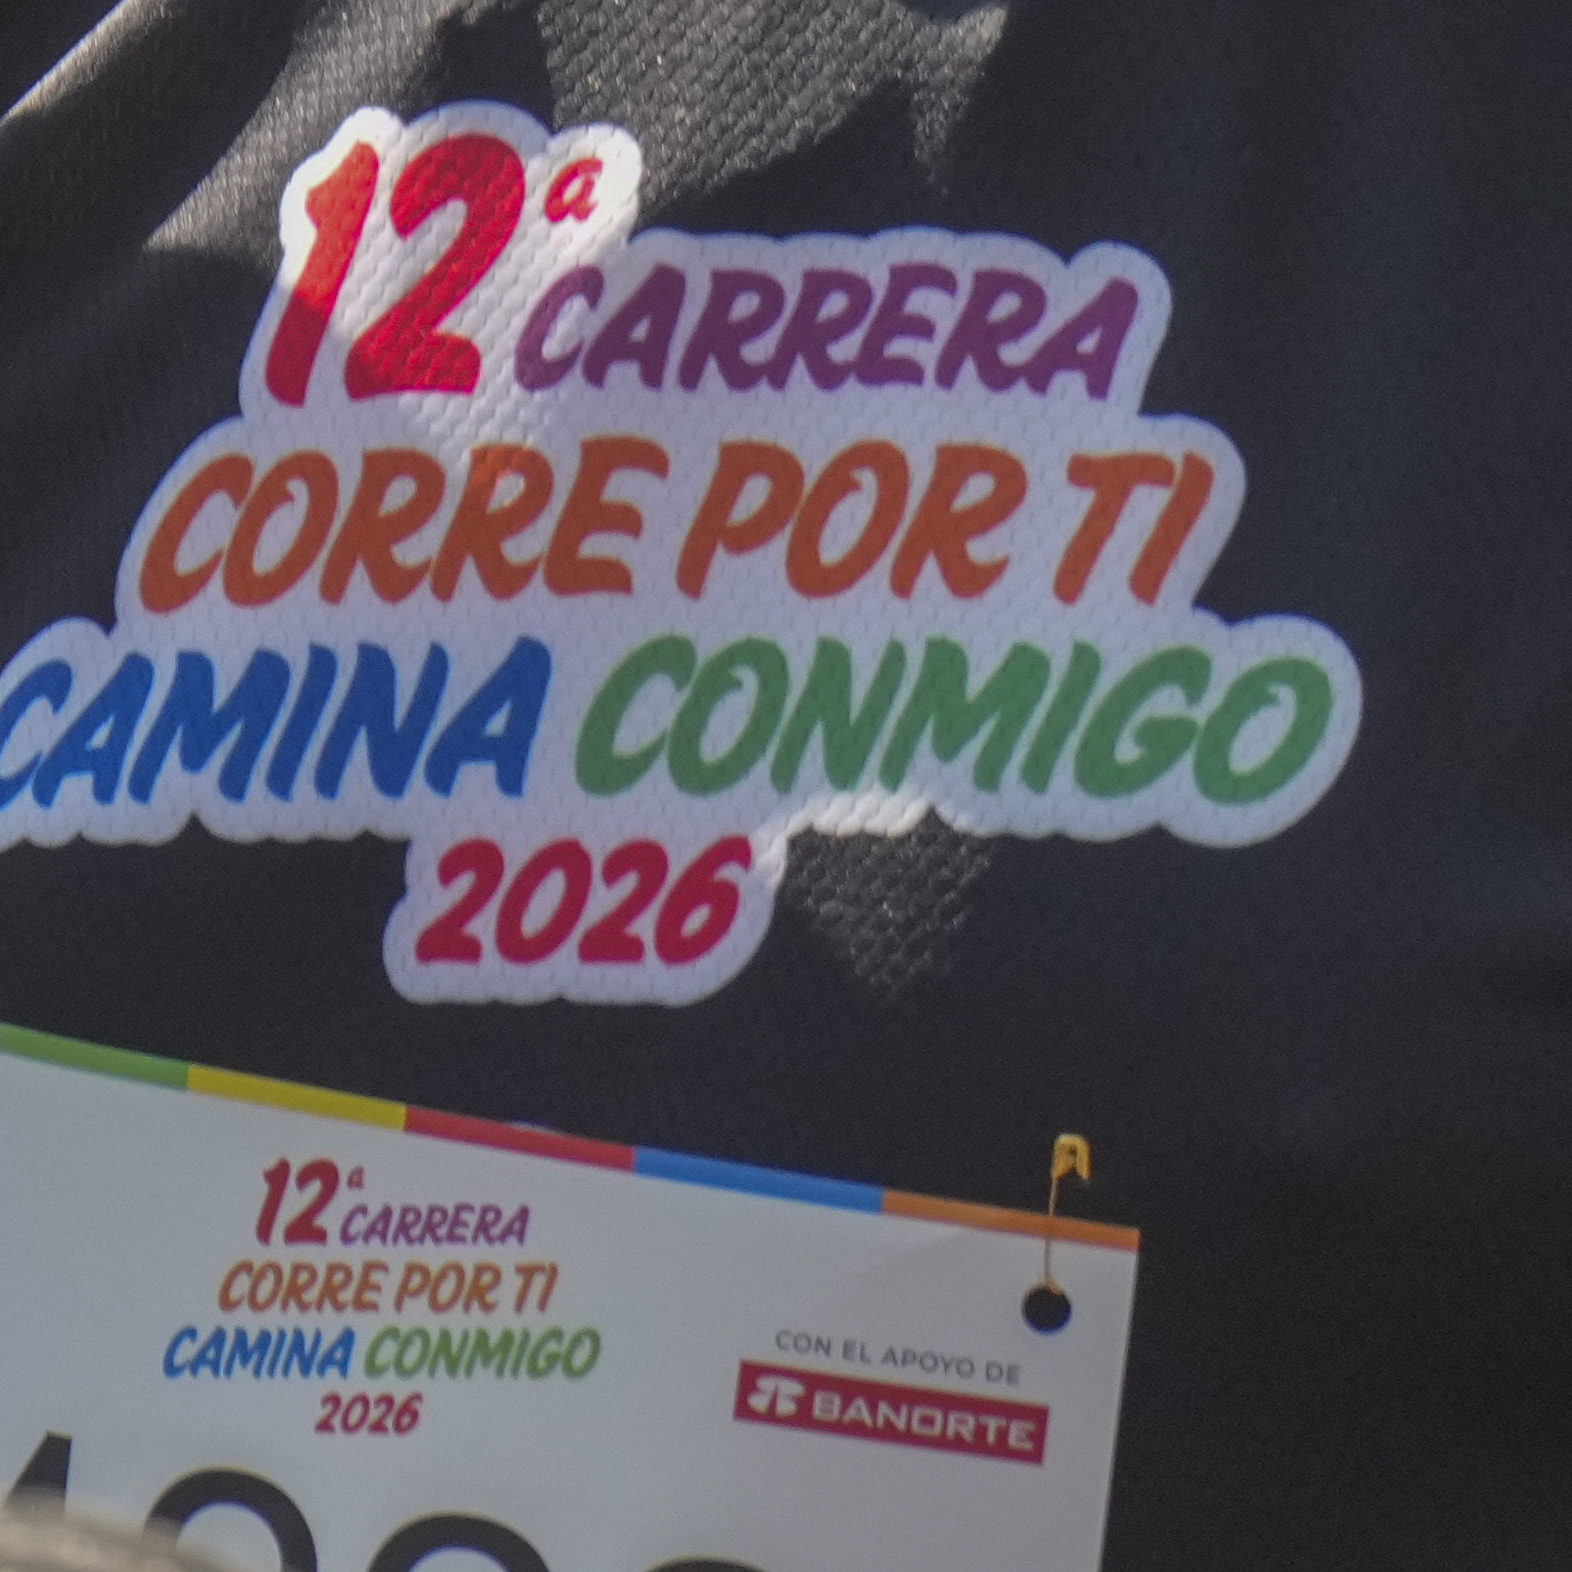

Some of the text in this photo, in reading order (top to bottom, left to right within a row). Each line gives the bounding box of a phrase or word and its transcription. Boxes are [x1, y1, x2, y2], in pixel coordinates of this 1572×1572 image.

[513, 261, 1139, 399] CARRERA
[138, 436, 1214, 615] CORRE POR TI
[574, 633, 1334, 805] CONMIGO
[414, 835, 753, 969] 2026
[339, 1202, 531, 1247] CARRERA
[217, 1260, 559, 1314] CORRE POR TI
[162, 1324, 602, 1381] CAMINA CONMIGO
[775, 1328, 1023, 1386] CON EL APOYO DE
[313, 1391, 424, 1436] 2026
[811, 1389, 1038, 1452] BANORTE
